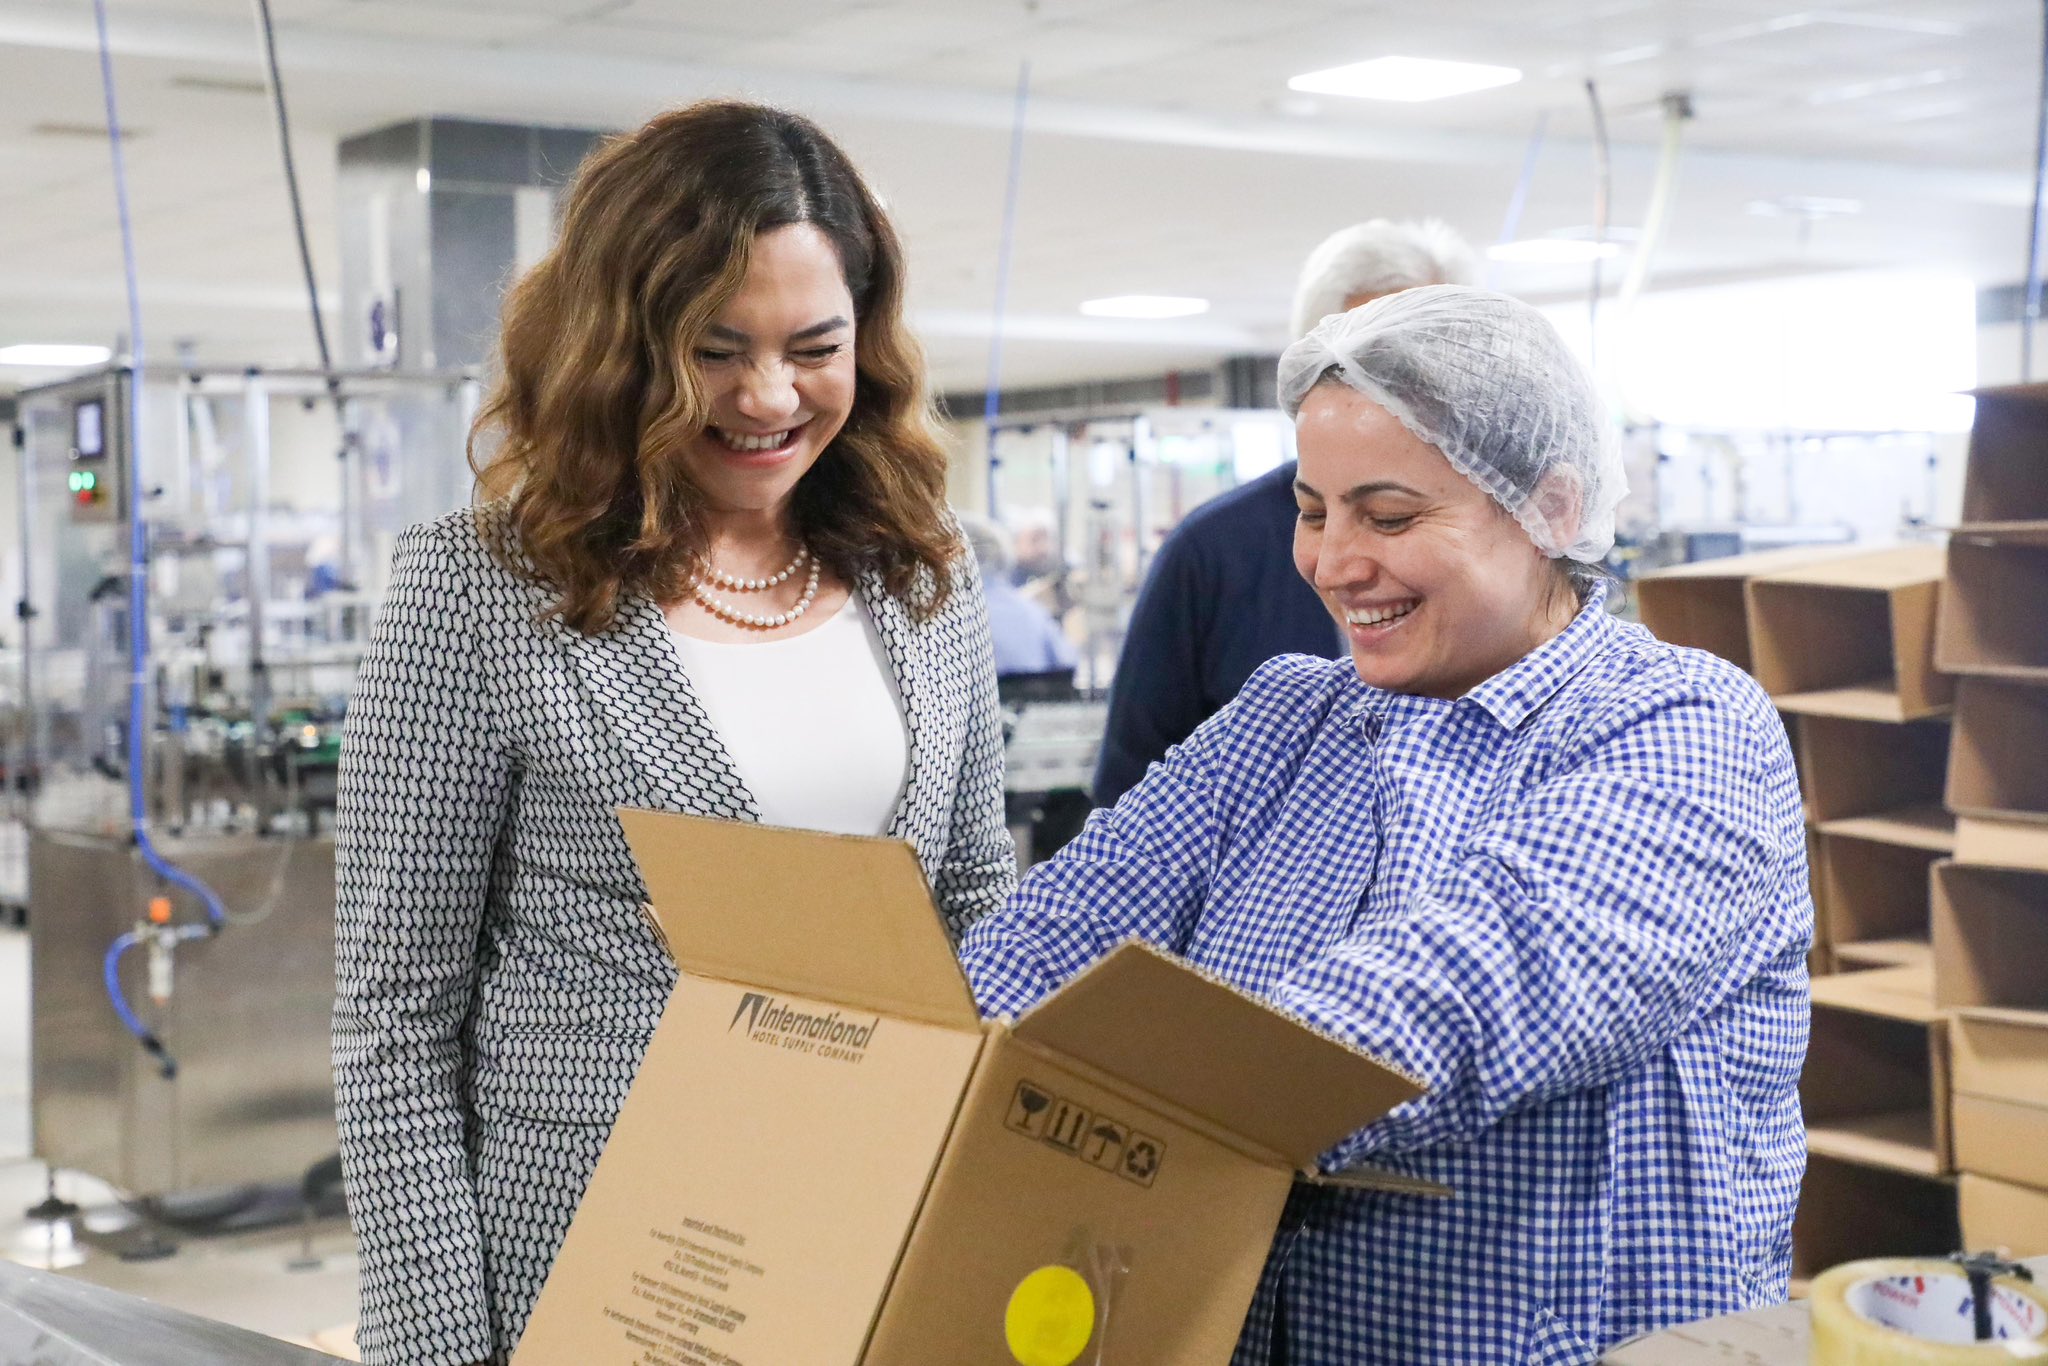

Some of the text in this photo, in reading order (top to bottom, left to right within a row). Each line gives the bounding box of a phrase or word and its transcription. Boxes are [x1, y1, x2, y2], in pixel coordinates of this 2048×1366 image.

[758, 998, 880, 1049] International
[752, 1030, 865, 1064] HOTEL SUPPLY COMPANY
